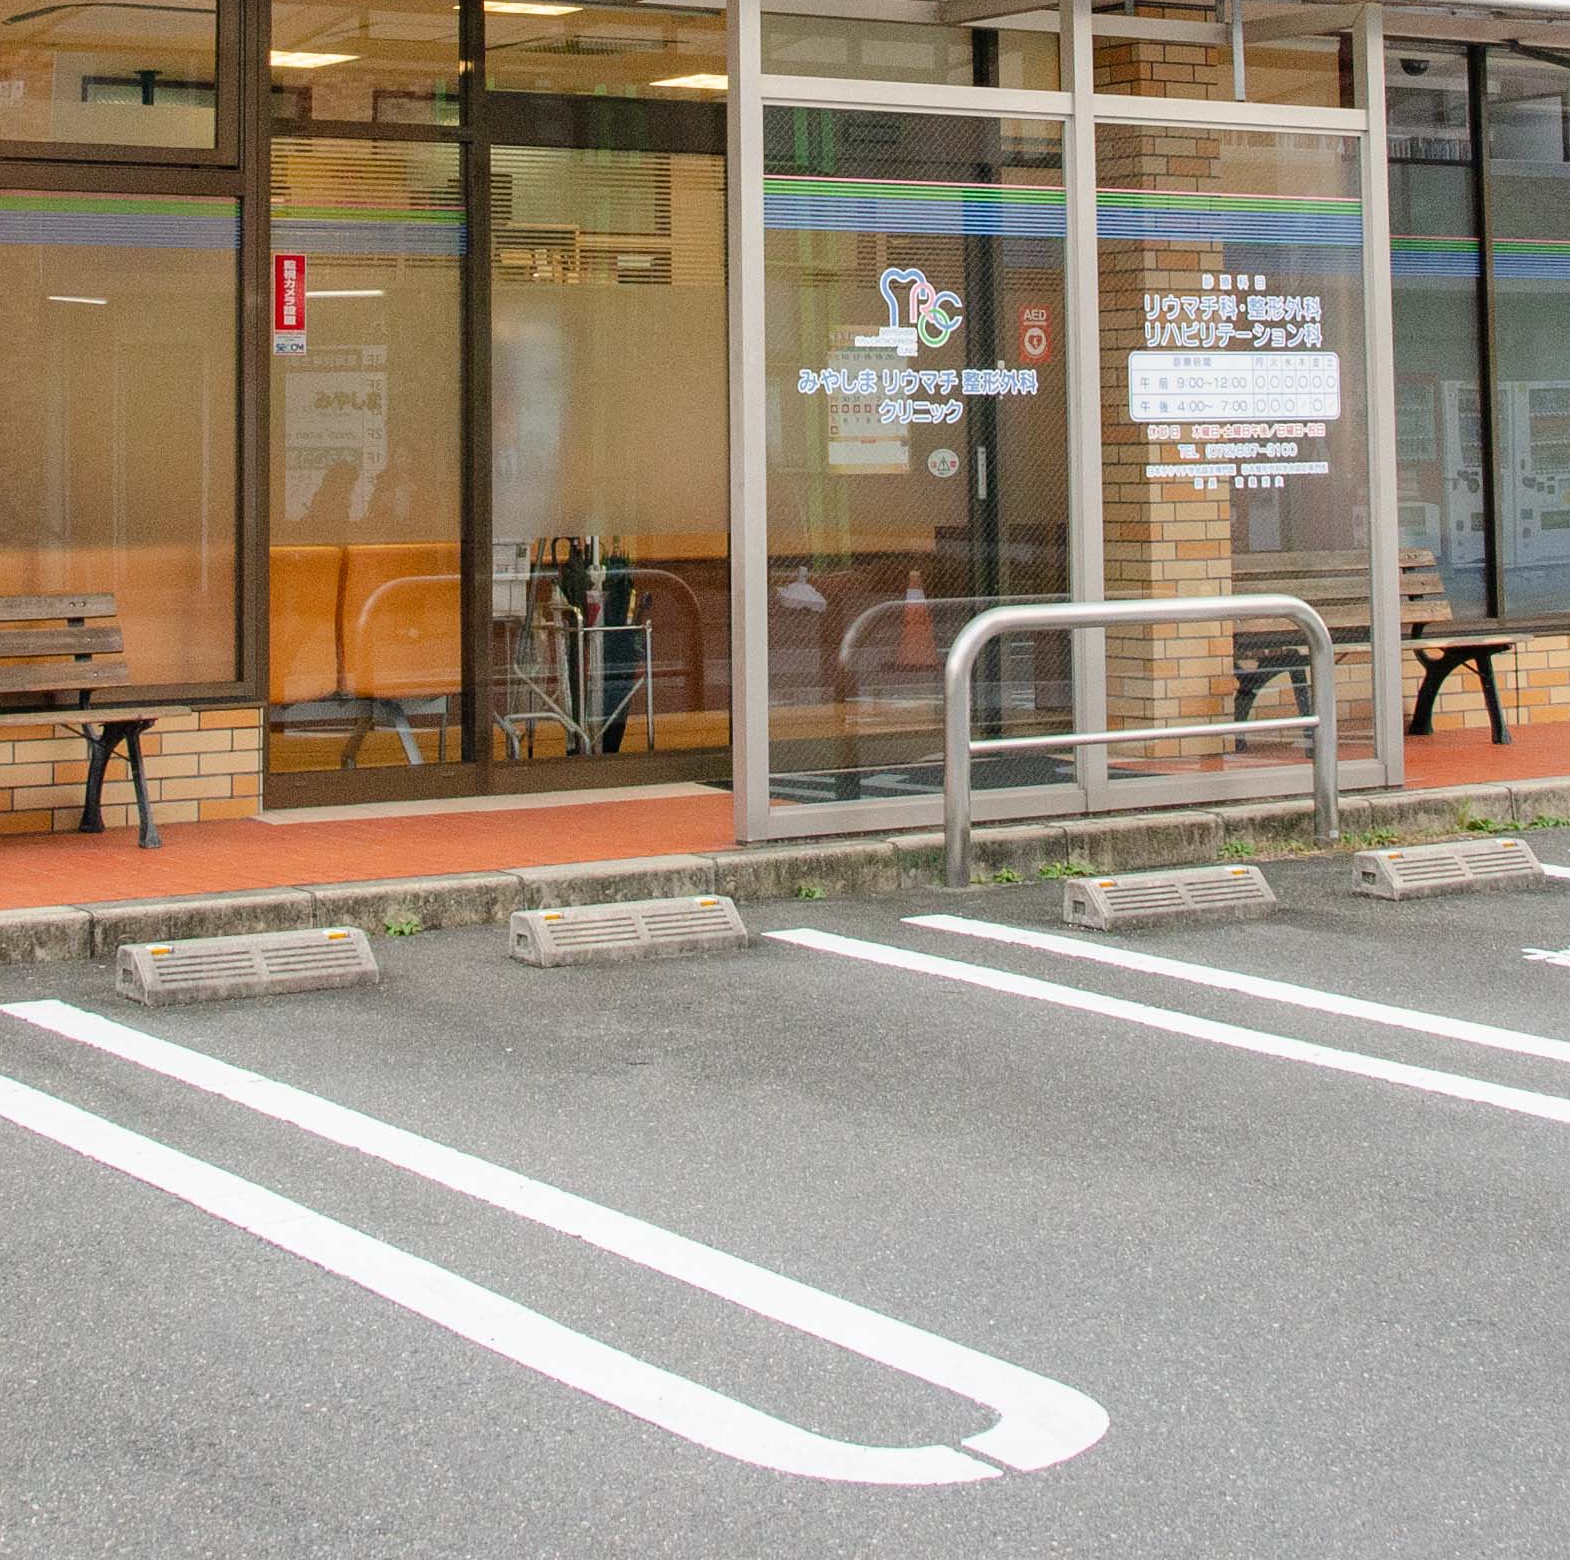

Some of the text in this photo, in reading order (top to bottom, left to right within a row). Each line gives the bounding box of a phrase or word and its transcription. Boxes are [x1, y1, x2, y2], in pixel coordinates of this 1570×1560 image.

[1023, 309, 1047, 321] AED
[1144, 294, 1321, 321] リウマチ科・整形外科
[1144, 321, 1323, 348] リハビリテーション科
[276, 343, 304, 352] SECOM
[798, 368, 1038, 394] みやしま リウマチ 整形外科
[878, 400, 963, 424] クリニック
[1177, 444, 1200, 459] TEL
